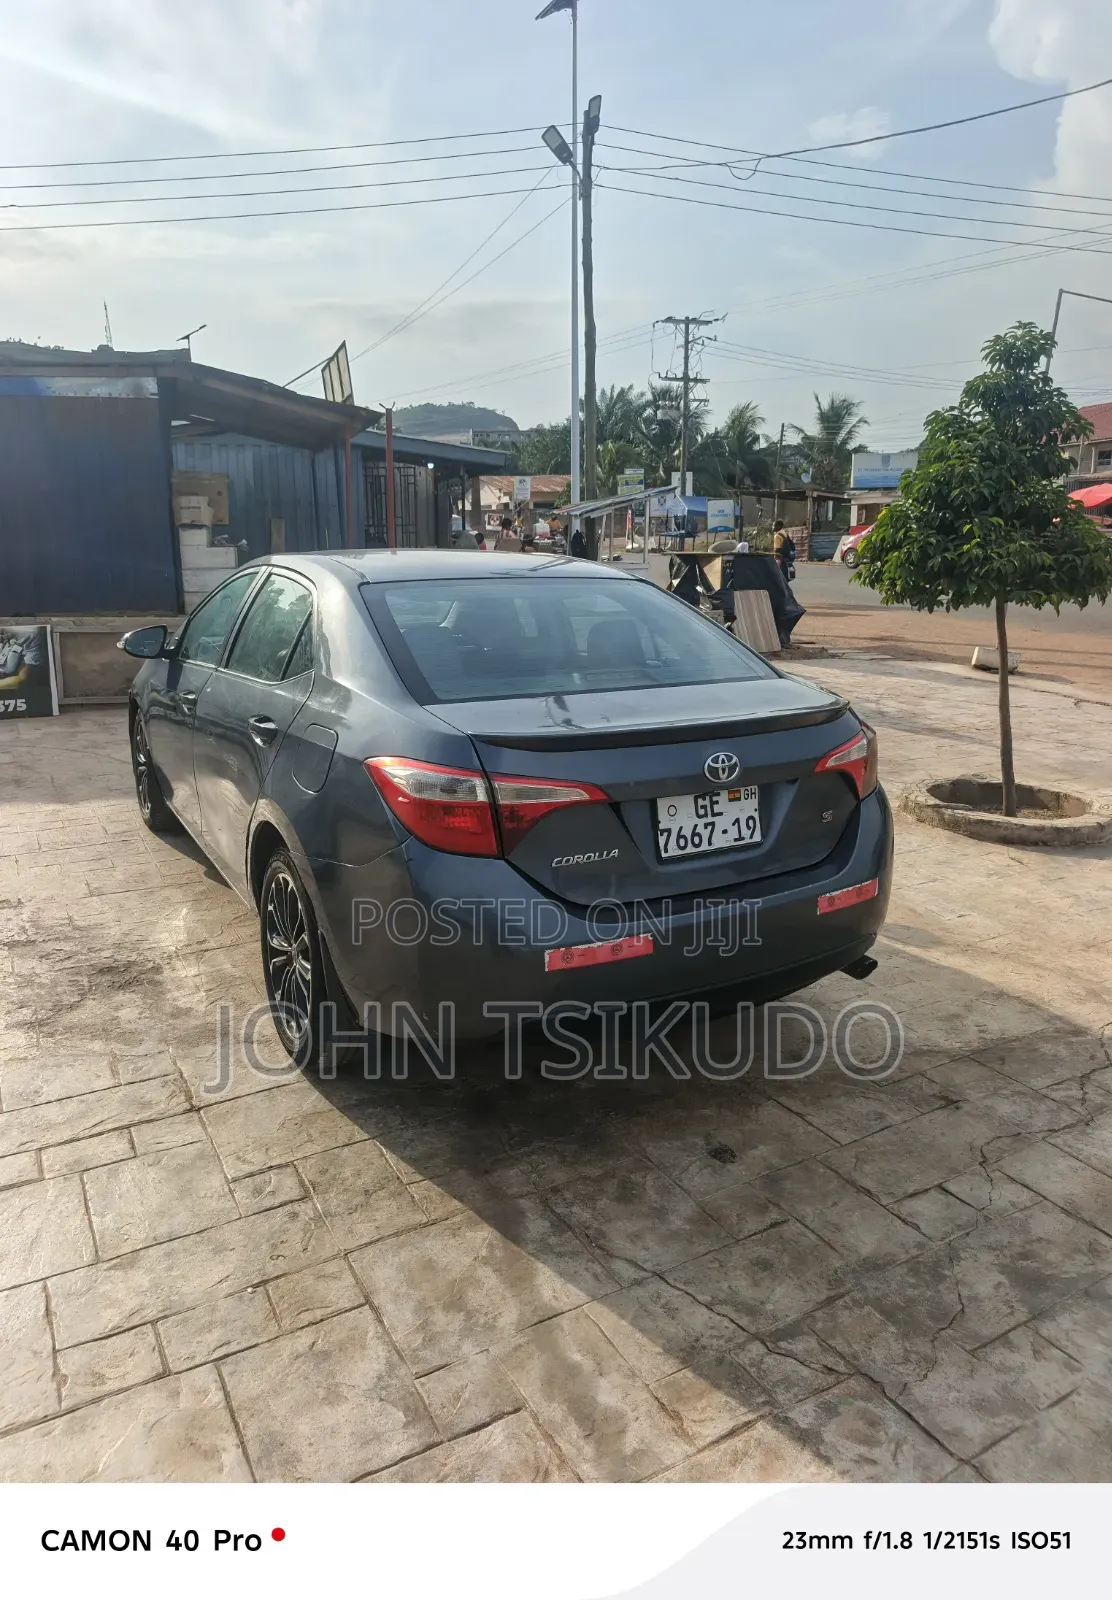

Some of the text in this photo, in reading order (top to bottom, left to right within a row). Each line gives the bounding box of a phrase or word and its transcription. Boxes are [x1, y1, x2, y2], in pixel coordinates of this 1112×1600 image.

[693, 787, 757, 820] GE GH
[659, 815, 757, 854] 7667-19
[551, 848, 619, 868] COROLLA
